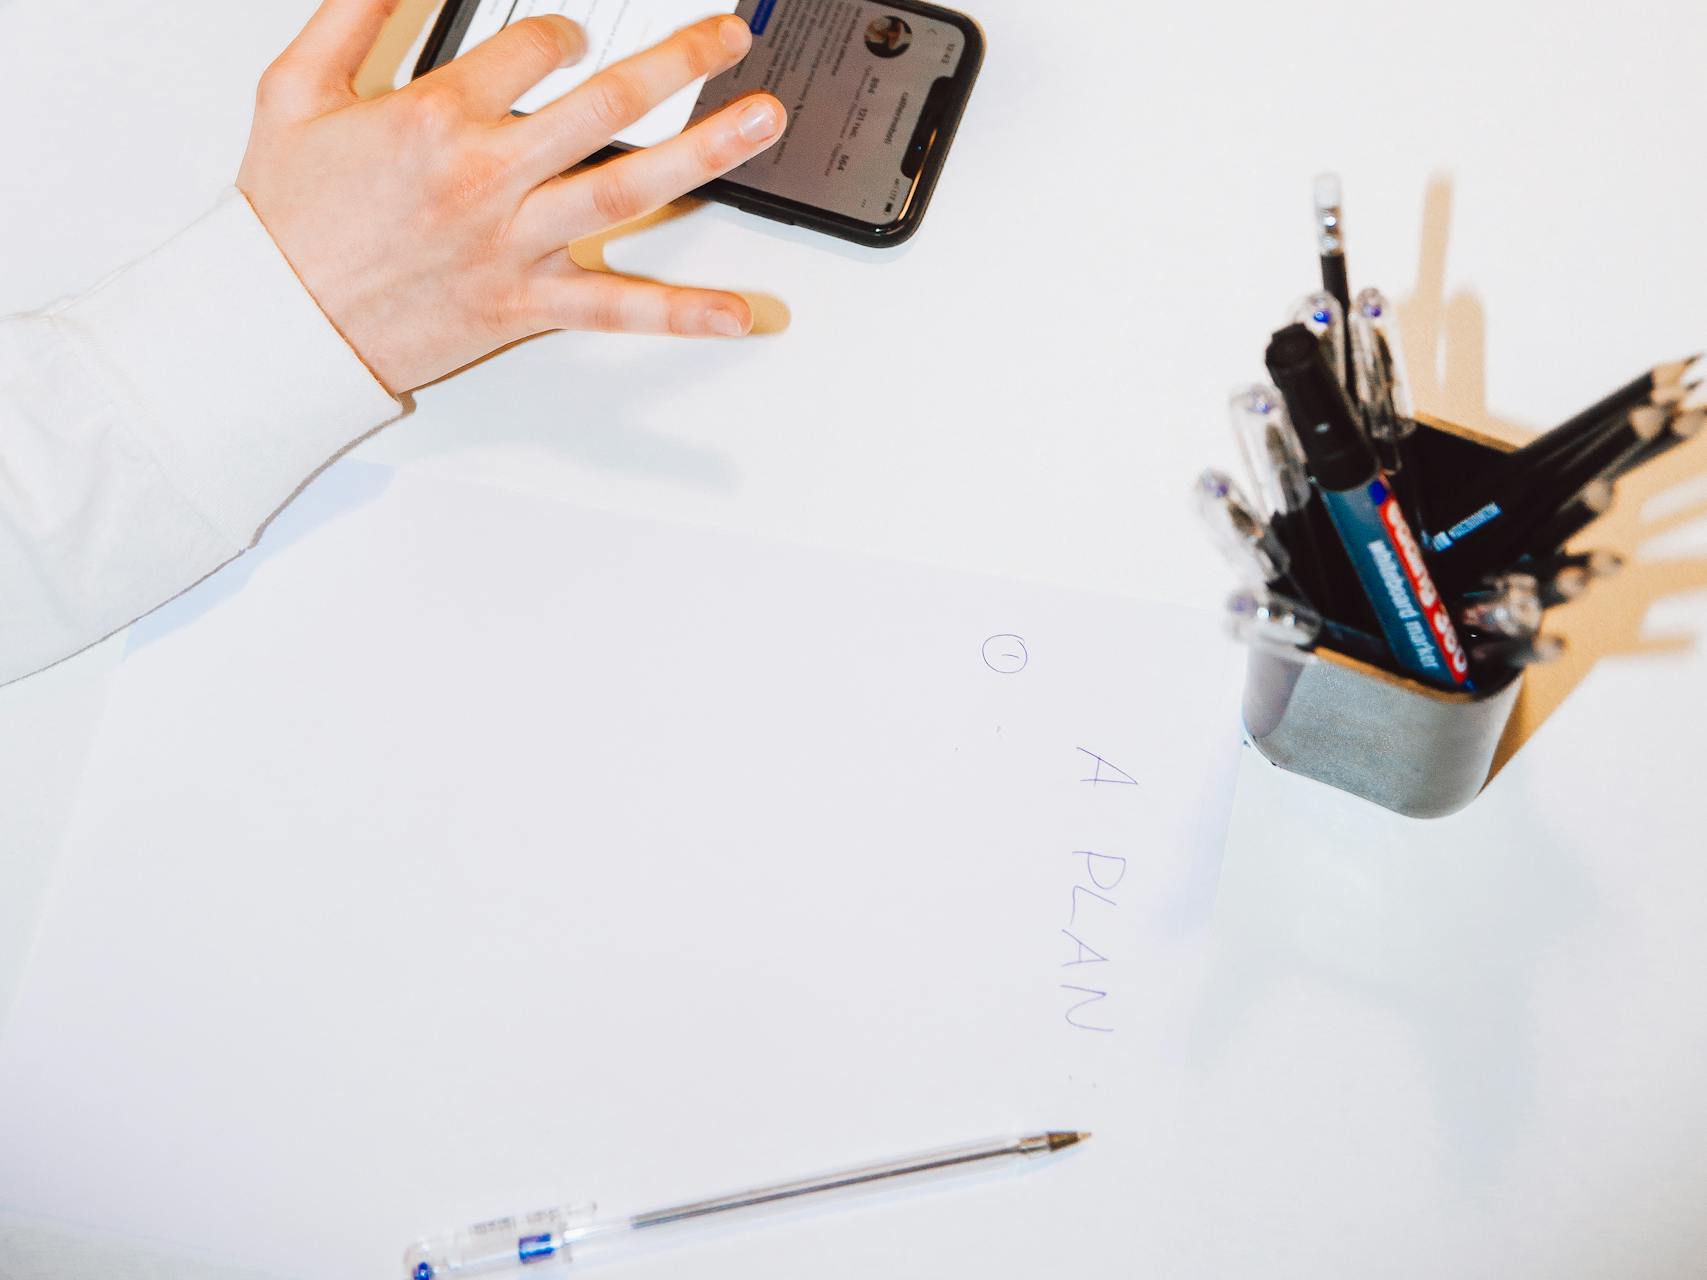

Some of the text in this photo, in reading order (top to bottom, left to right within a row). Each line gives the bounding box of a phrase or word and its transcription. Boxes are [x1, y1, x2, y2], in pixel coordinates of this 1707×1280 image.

[1367, 539, 1440, 669] whiteboard marker
[1059, 746, 1138, 1032] A PLAN
